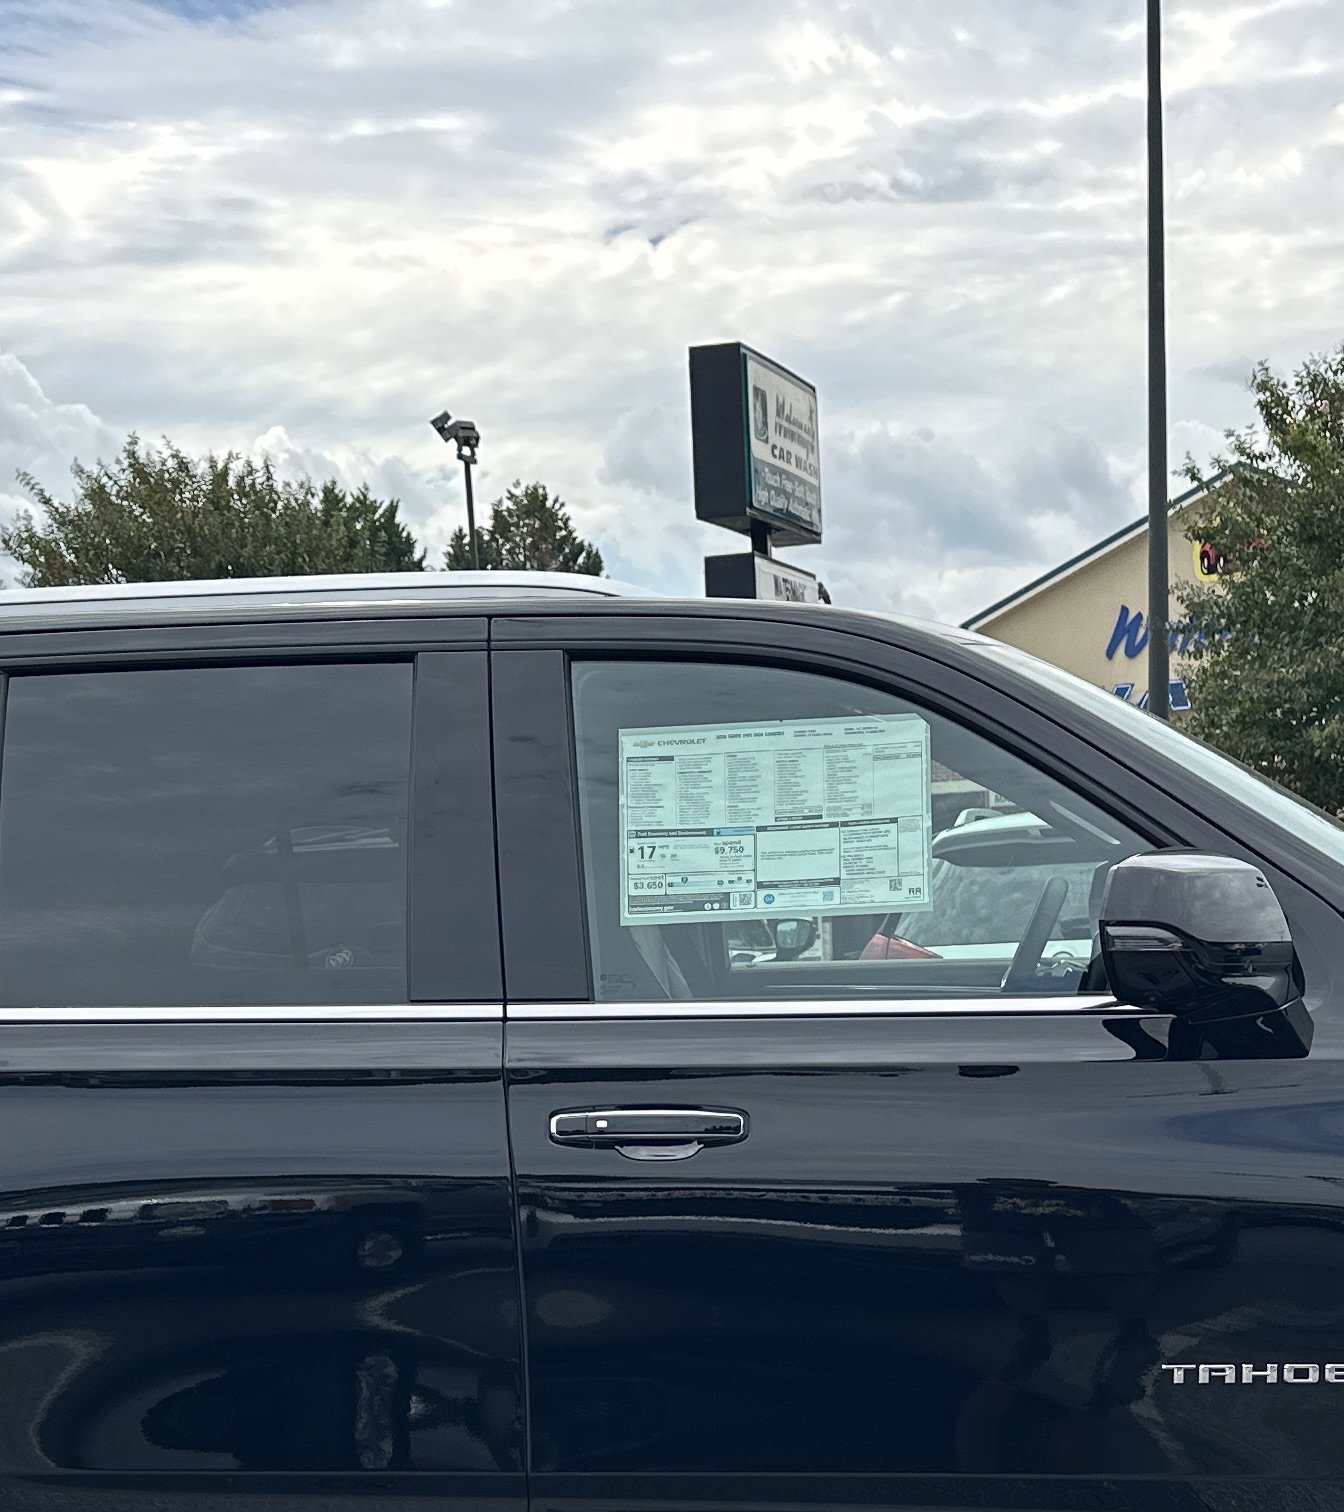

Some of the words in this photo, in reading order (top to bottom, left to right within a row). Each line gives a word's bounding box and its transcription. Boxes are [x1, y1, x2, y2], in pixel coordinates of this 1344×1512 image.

[771, 444, 792, 465] CAR
[795, 453, 818, 479] WASH
[657, 738, 707, 747] CHEVROLET
[637, 845, 656, 860] 17
